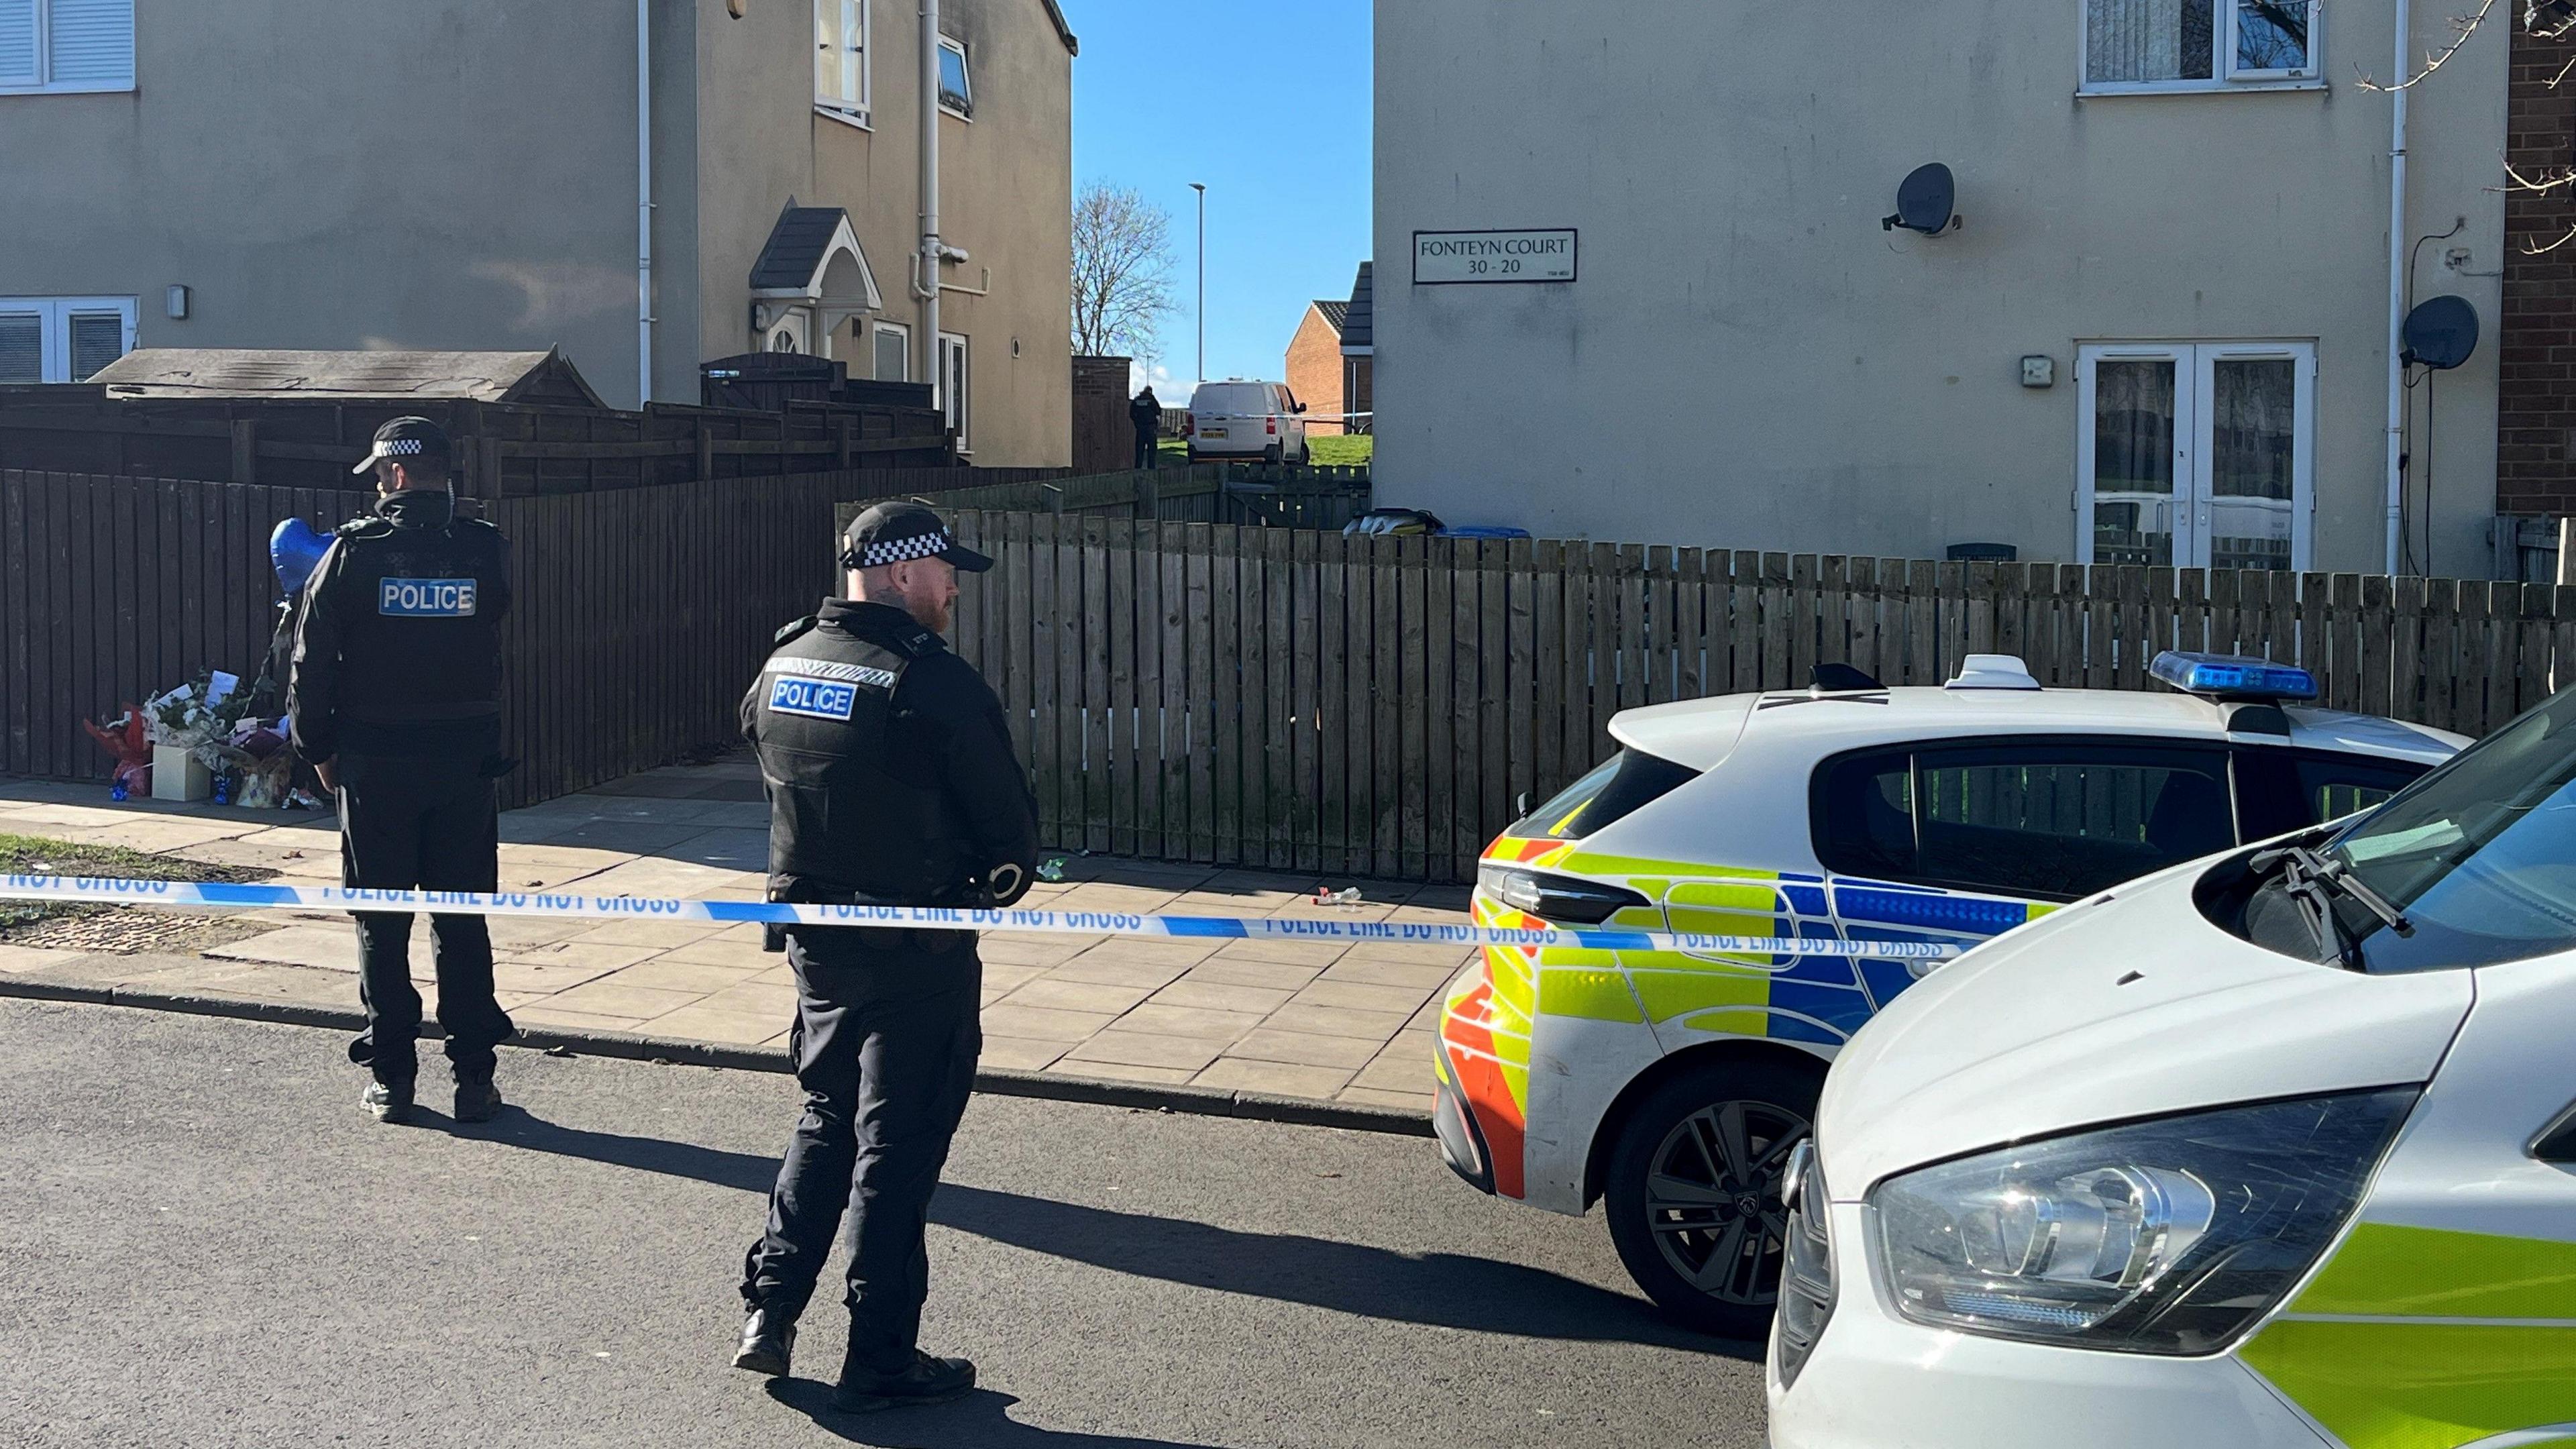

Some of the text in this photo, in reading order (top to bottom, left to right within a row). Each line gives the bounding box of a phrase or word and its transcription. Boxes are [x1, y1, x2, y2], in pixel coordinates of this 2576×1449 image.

[1421, 239, 1567, 256] FONTEYN COURT
[1468, 260, 1487, 274] 30
[1501, 260, 1520, 273] 20
[384, 585, 474, 609] POLICE
[774, 682, 849, 712] POLICE
